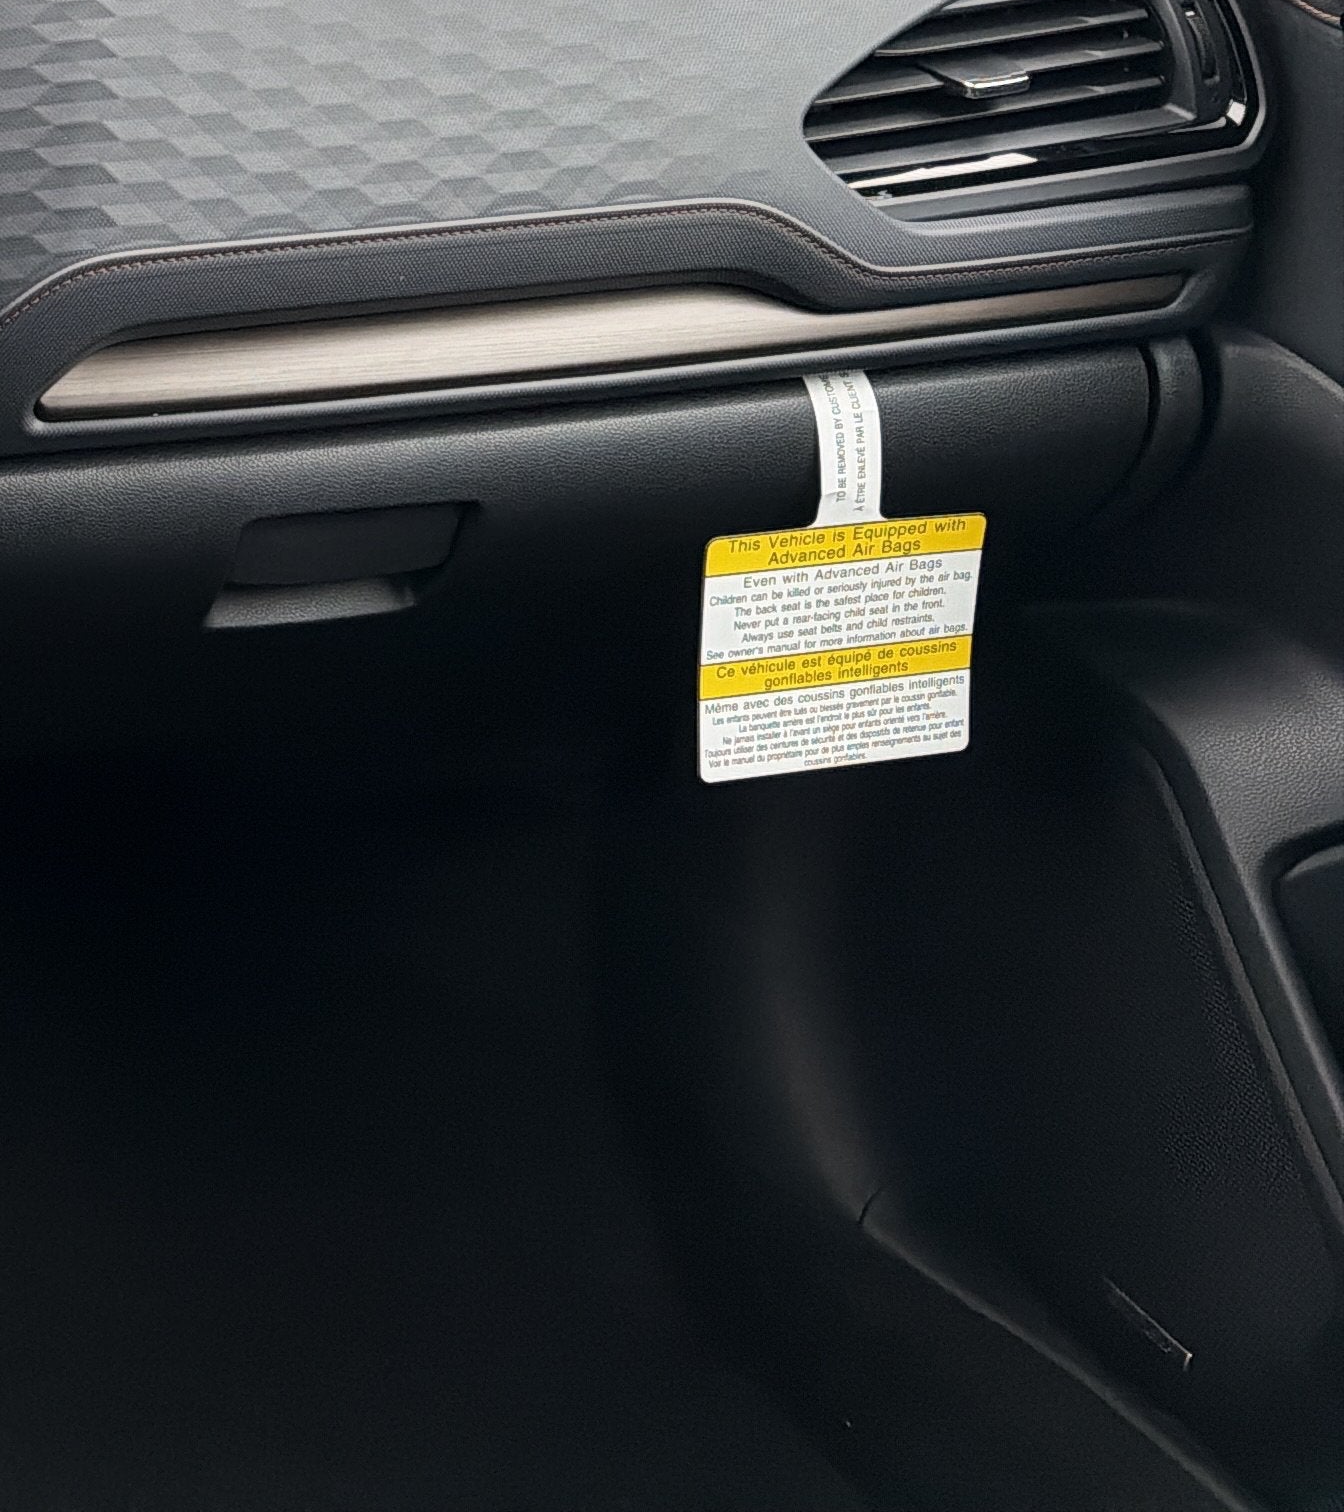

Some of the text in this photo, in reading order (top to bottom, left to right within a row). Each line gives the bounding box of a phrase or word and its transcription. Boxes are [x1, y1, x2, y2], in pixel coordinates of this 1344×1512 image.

[843, 380, 861, 410] CLIENT
[833, 418, 844, 430] BY
[853, 412, 863, 423] LE
[856, 427, 865, 445] PAR
[836, 433, 847, 475] REMOVED
[836, 490, 847, 503] TO
[838, 477, 847, 489] BE
[729, 518, 966, 553] This Vehicle is Equipped with
[768, 541, 921, 565] Advanced Air Bags
[709, 594, 747, 606] Children
[751, 593, 767, 602] can
[772, 589, 783, 599] be
[787, 586, 810, 598] killed
[814, 587, 824, 595] or
[827, 580, 867, 594] seriously
[871, 576, 901, 591] injured
[905, 575, 916, 588] by
[920, 573, 934, 584] the
[938, 571, 950, 582] air
[744, 559, 942, 588] Even with Advanced Air Bags
[734, 620, 761, 630] Never
[765, 615, 779, 630] put
[793, 610, 840, 623] rear-facing
[844, 606, 865, 618] child
[869, 603, 889, 615] seat
[892, 602, 900, 612] in
[904, 601, 918, 611] the
[922, 597, 945, 609] front.
[735, 586, 946, 617] The back seat is the safest place for children.
[706, 650, 724, 660] See
[728, 645, 763, 658] owner's
[767, 640, 800, 653] manual
[804, 639, 817, 649] for
[820, 637, 843, 647] more
[847, 630, 896, 644] information
[900, 625, 925, 638] about
[928, 624, 940, 635] air
[741, 632, 773, 643] Always
[778, 630, 794, 639] use
[798, 625, 817, 636] seat
[821, 622, 843, 634] belts
[846, 620, 863, 631] and
[867, 617, 888, 629] child
[716, 640, 957, 678] Ce véhicule est équipé de coussins
[764, 659, 909, 691] gonflables intelligents
[744, 699, 769, 710] avec
[774, 695, 793, 706] des
[798, 689, 845, 703] coussins
[850, 681, 904, 700] gonflables
[909, 673, 965, 690] intelligents
